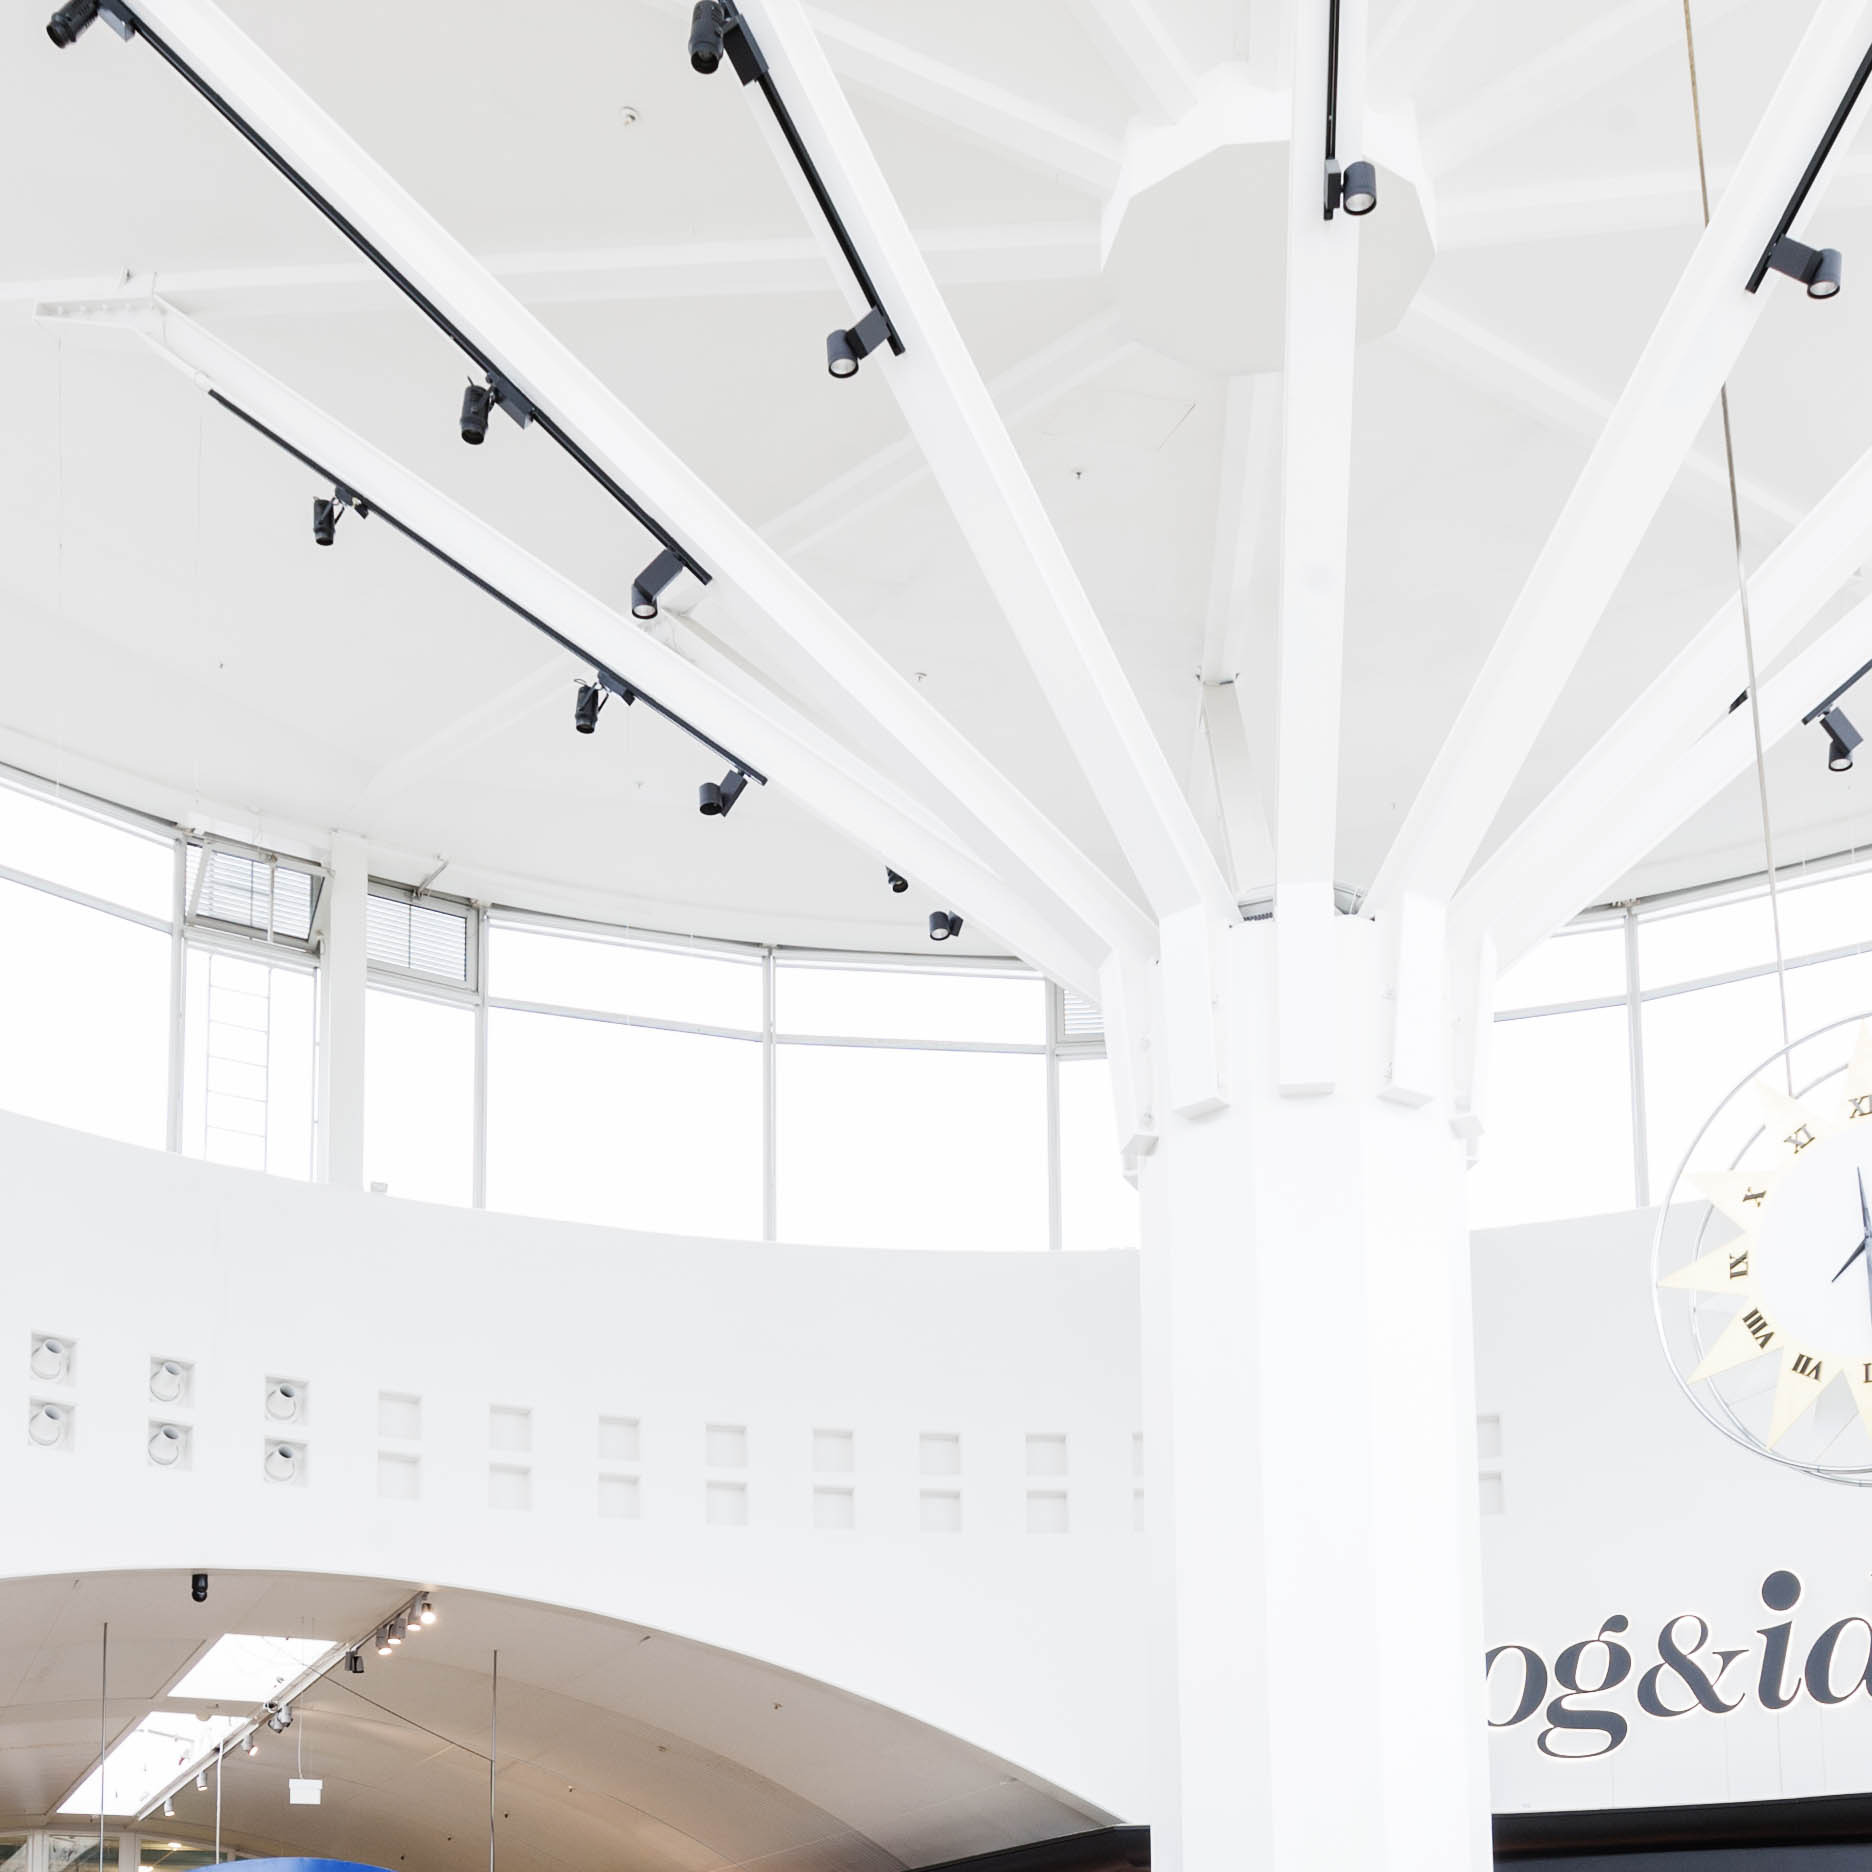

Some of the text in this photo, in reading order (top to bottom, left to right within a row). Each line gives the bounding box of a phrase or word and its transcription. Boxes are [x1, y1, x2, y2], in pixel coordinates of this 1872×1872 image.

[1783, 1123, 1816, 1154] XI
[1742, 1186, 1767, 1208] X
[1729, 1250, 1749, 1280] IX
[1741, 1307, 1775, 1349] VIII
[1792, 1353, 1823, 1382] VII
